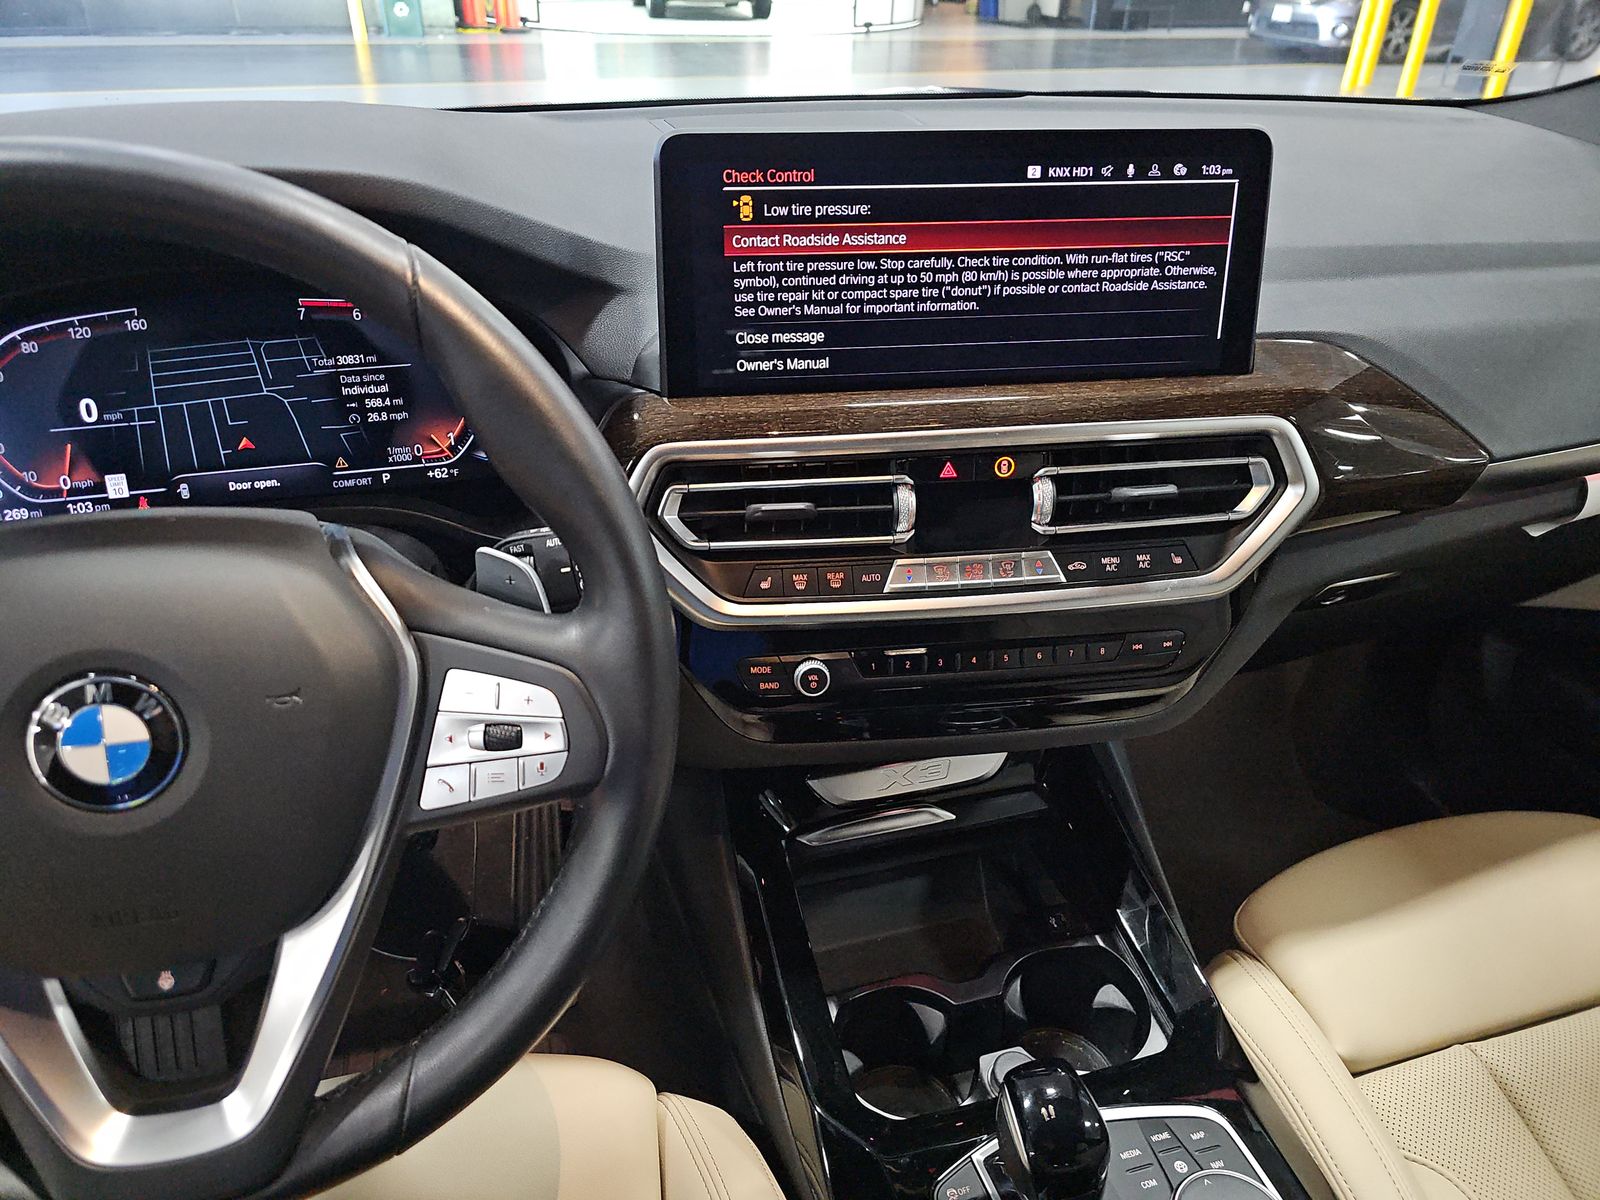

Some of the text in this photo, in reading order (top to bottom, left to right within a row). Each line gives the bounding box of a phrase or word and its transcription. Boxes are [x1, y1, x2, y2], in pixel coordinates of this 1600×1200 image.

[723, 168, 815, 184] Check Control
[1048, 166, 1070, 178] KNX
[1072, 166, 1094, 177] HD1
[763, 202, 871, 219] Low tire pressure:
[732, 232, 907, 249] Contact Roadside Assistance
[733, 250, 1191, 273] Left front tire pressure low. Stop carefully. Check tire condition. With run-flat tires ("RSC"
[734, 264, 1217, 289] symbol), continued driving at up to 50 mph (80 km/h) is possible where appropriate. Otherwise,
[734, 279, 1208, 303] use tire repair kit or compact spare tire ("donut") if possible or contact Roadside Assistance.
[297, 308, 305, 321] 7
[352, 308, 362, 321] 6
[735, 300, 980, 317] See Owner's Manual for important information.
[124, 318, 148, 331] 160
[67, 327, 92, 339] 120
[735, 331, 825, 345] Close message
[20, 341, 39, 354] 80
[311, 354, 377, 368] Total 30831 mi
[736, 357, 829, 373] Owner's Manual
[340, 373, 385, 384] Data since
[341, 383, 389, 396] Individual
[365, 397, 404, 409] 568.4 mi
[78, 397, 123, 424] 0 mph
[367, 411, 409, 423] 26.8 mph
[387, 445, 411, 456] 1/min
[414, 444, 423, 457] 0
[388, 454, 412, 463] x1000
[22, 471, 38, 482] 10
[59, 475, 94, 490] 0 mph
[332, 477, 373, 488] COMFORT
[382, 473, 391, 484] P
[228, 480, 281, 491] Door open.
[112, 487, 125, 497] 10
[3, 508, 43, 522] 269 mi
[66, 502, 94, 516] 1:03
[546, 537, 562, 548] AUT
[509, 544, 525, 554] FAST
[1101, 556, 1121, 566] MENU
[1136, 553, 1151, 562] MAX
[1106, 563, 1118, 572] A/C
[1138, 561, 1151, 570] A/C
[792, 574, 808, 582] MAX
[826, 572, 845, 580] REAR
[861, 573, 881, 582] AUTO
[750, 666, 772, 674] MODE
[905, 660, 911, 669] 2
[759, 682, 780, 690] BAND
[41, 682, 164, 730] BMW
[877, 759, 951, 791] X3
[1150, 1130, 1172, 1143] HOME
[1189, 1130, 1206, 1141] MAP
[1119, 1148, 1143, 1161] MEDIA
[1210, 1160, 1225, 1170] NAV
[1140, 1178, 1158, 1190] COM
[956, 1186, 971, 1197] OFF
